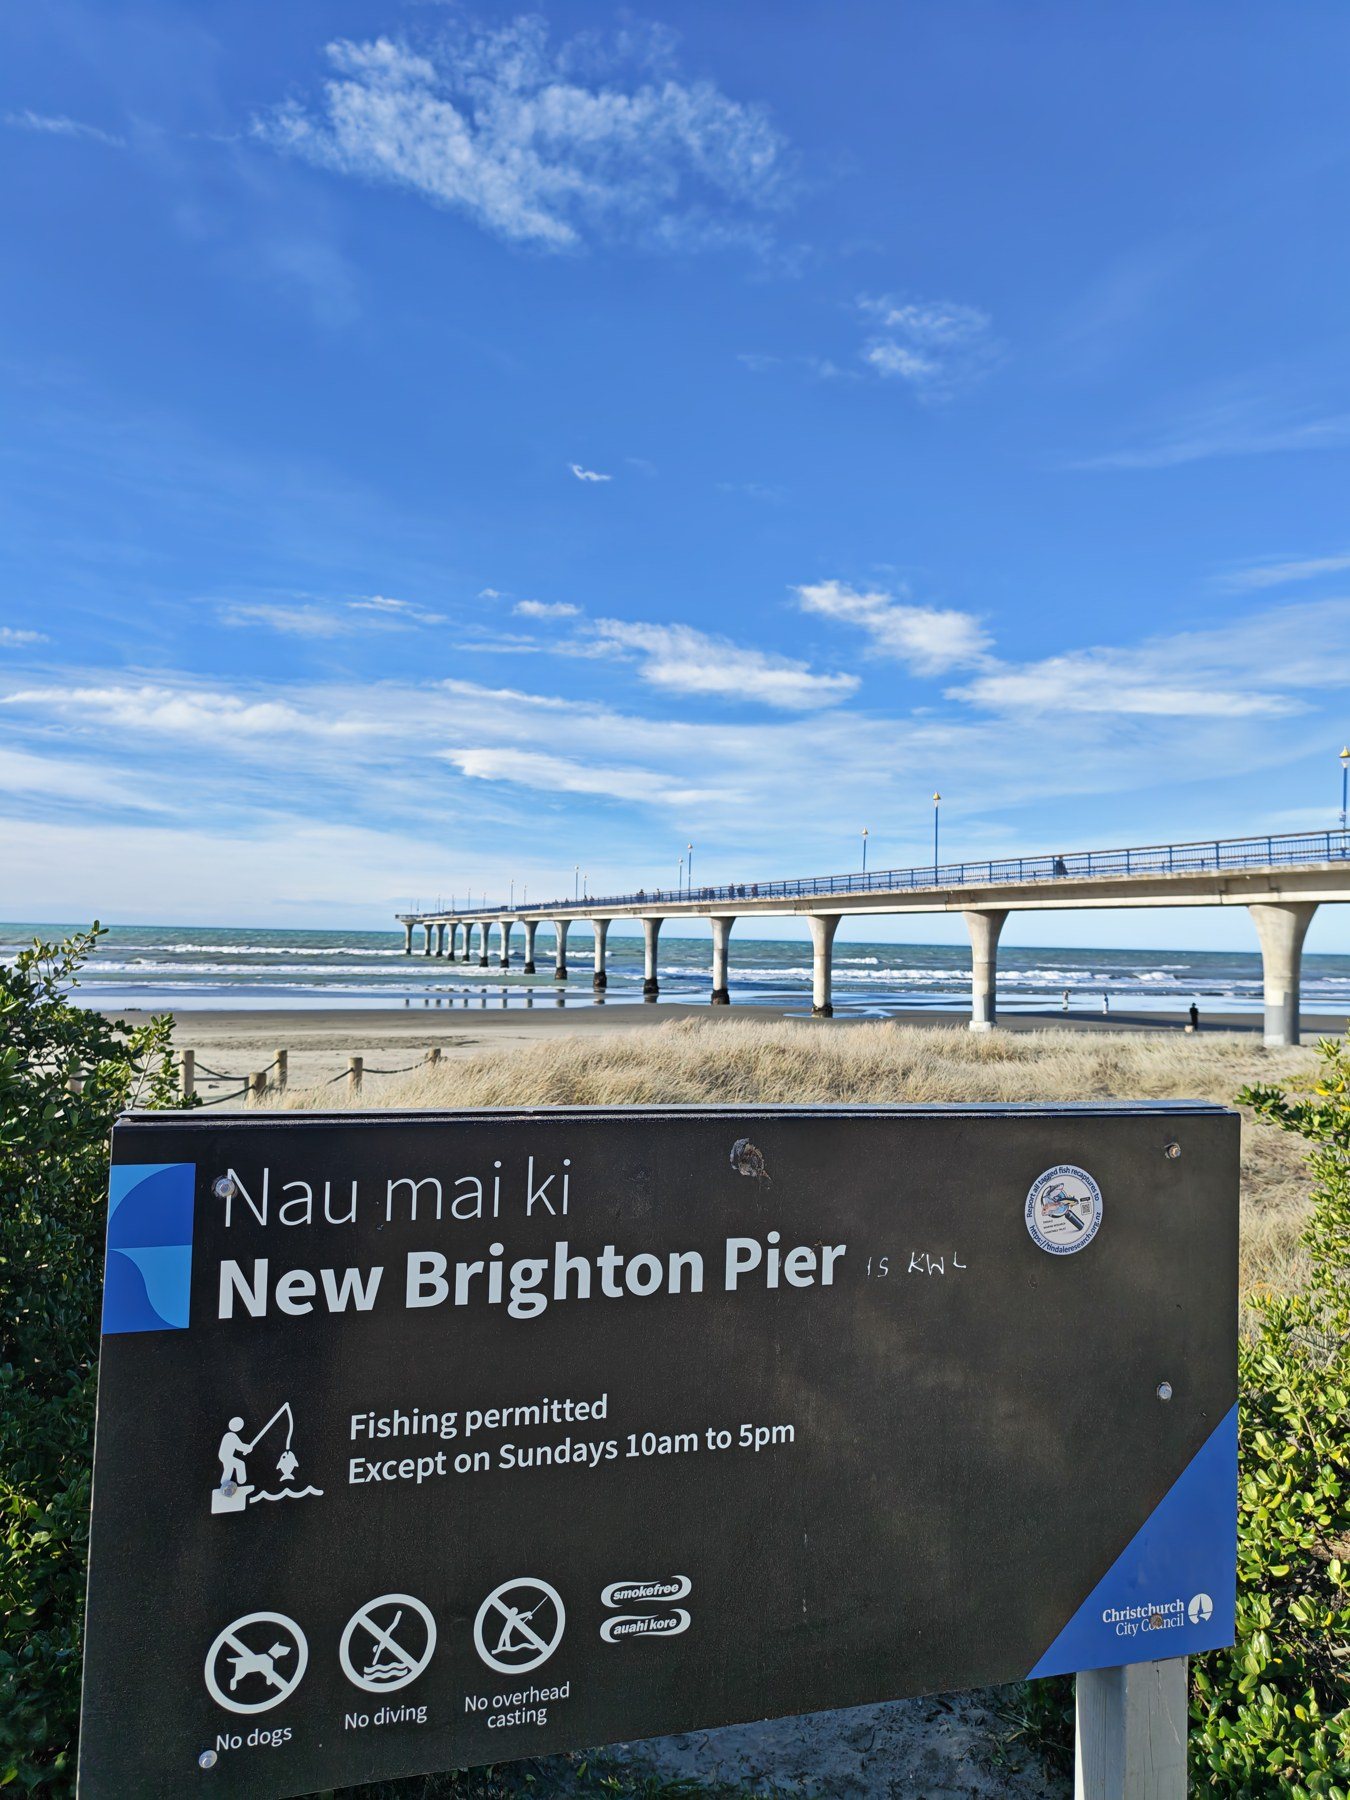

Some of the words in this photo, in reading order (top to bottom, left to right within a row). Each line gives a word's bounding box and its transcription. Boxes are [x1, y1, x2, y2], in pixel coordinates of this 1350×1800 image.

[224, 1167, 358, 1228] Nau
[385, 1160, 502, 1222] mai
[526, 1155, 571, 1217] ki
[1026, 1193, 1036, 1218] Report
[1038, 1168, 1059, 1185] tagged
[1058, 1166, 1071, 1175] fish
[1071, 1168, 1097, 1193] recaptures
[1094, 1193, 1100, 1201] to
[218, 1258, 385, 1320] New
[405, 1241, 704, 1320] Brighton
[724, 1230, 847, 1291] Pier
[350, 1407, 458, 1441] Fishing
[465, 1393, 608, 1437] permitted
[348, 1451, 447, 1484] Except
[454, 1451, 490, 1474] on
[498, 1437, 618, 1469] Sundays
[625, 1432, 698, 1458] 10am
[705, 1427, 732, 1449] to
[738, 1423, 795, 1452] 5pm
[613, 1584, 679, 1600] smokefree
[1102, 1599, 1185, 1623] Christchurch
[613, 1619, 648, 1635] auahi
[649, 1618, 677, 1631] kore
[1115, 1621, 1139, 1637] City
[464, 1695, 488, 1713] No
[492, 1680, 570, 1708] overhead
[344, 1712, 370, 1730] No
[373, 1704, 428, 1725] diving
[487, 1706, 548, 1729] casting
[216, 1733, 243, 1751] No
[246, 1726, 292, 1747] dogs
